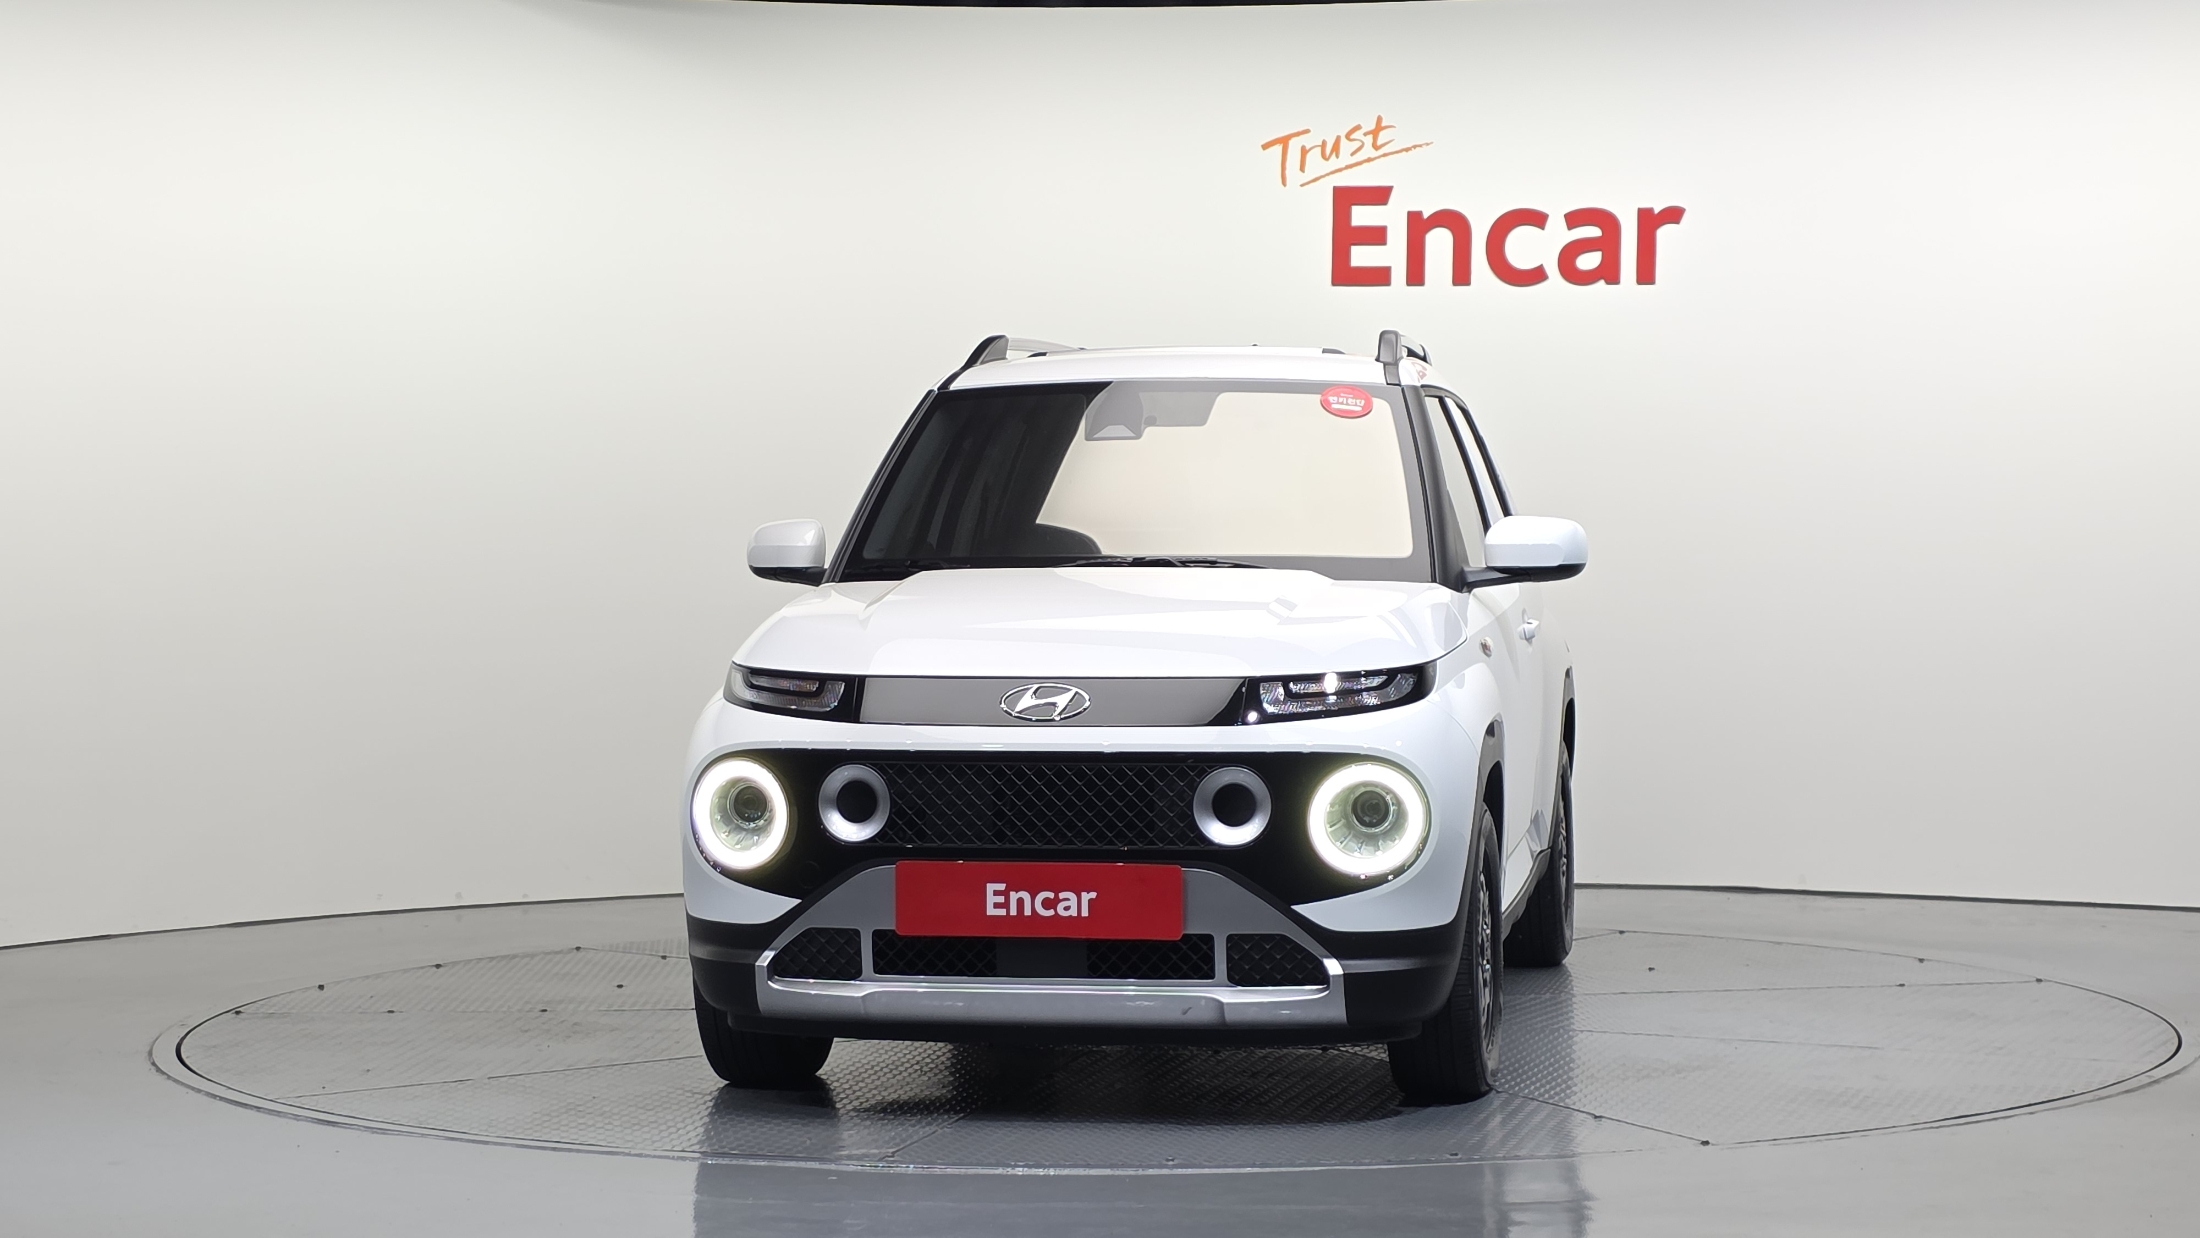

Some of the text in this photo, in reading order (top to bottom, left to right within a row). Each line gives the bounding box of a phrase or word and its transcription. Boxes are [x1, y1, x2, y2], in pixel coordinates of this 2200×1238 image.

[1261, 115, 1397, 188] Trust
[1331, 185, 1686, 287] Encar
[986, 883, 1097, 917] Encar
